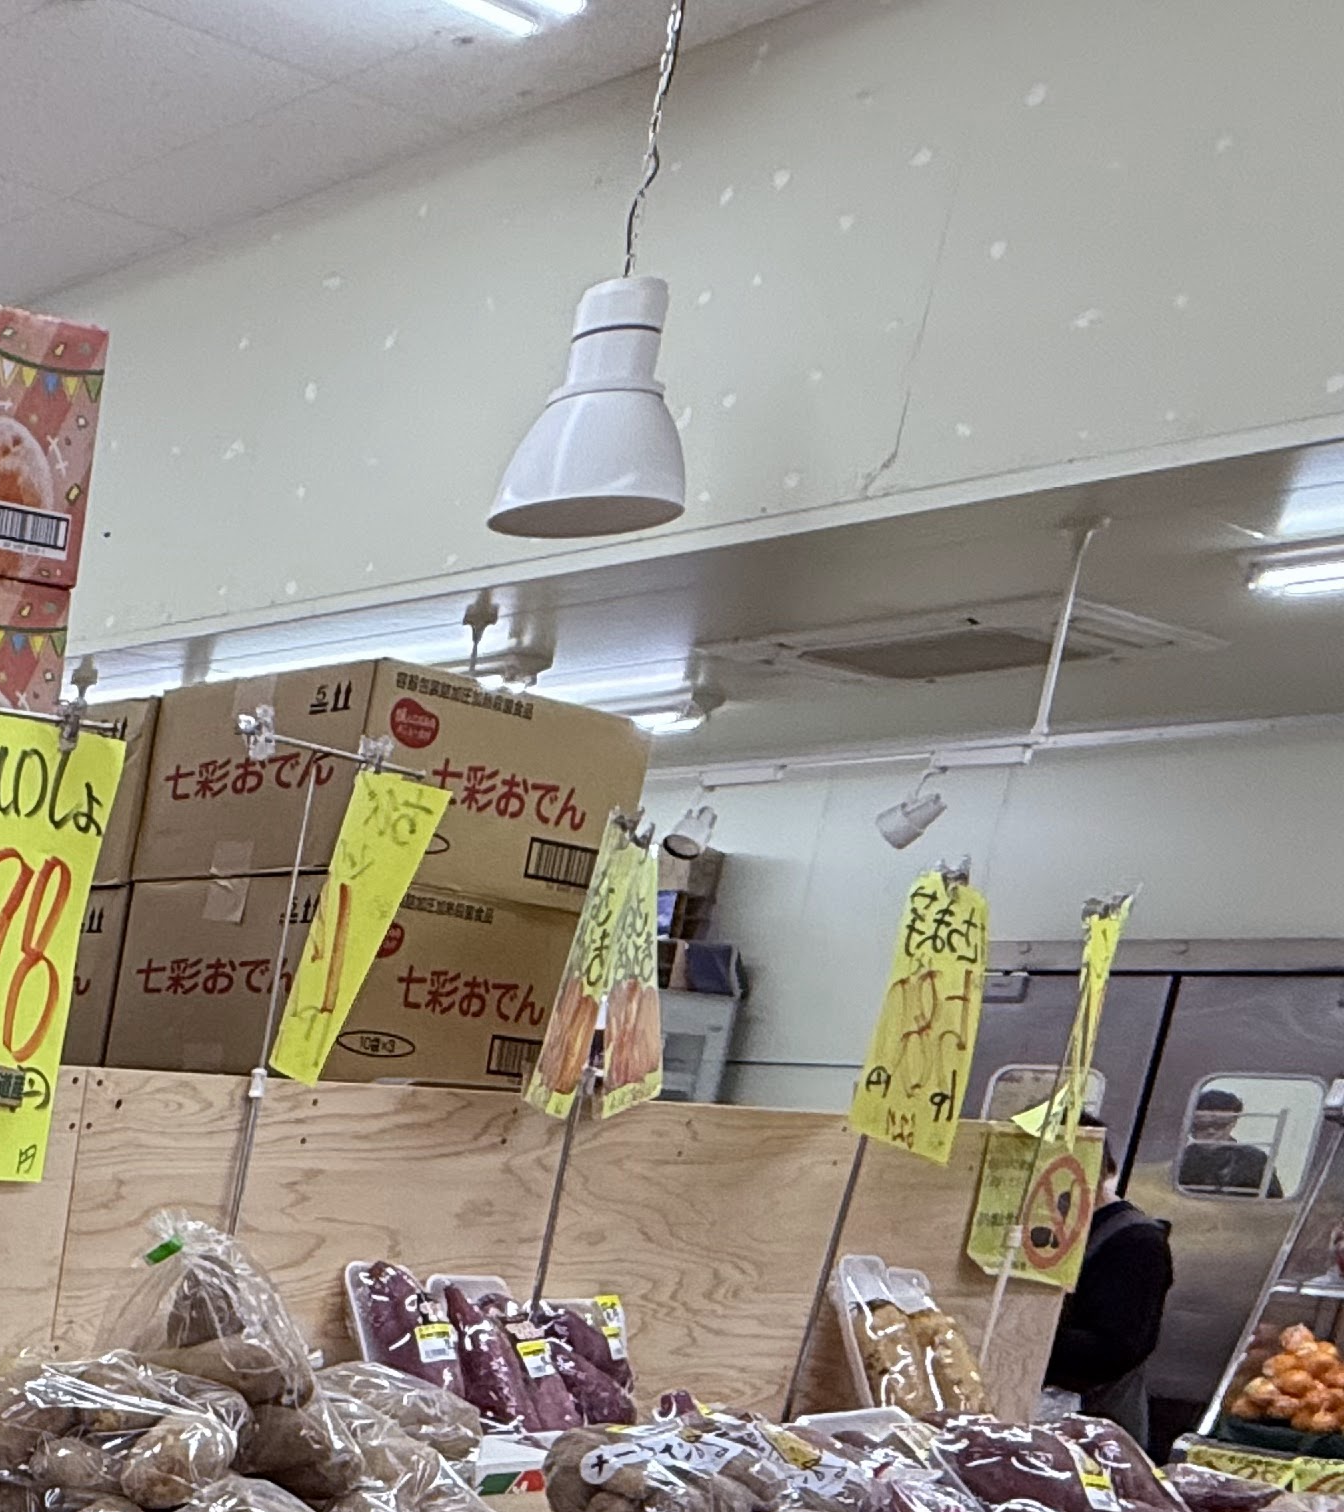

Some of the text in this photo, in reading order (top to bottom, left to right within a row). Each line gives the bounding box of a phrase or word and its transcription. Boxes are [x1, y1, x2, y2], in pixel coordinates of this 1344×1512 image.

[163, 752, 335, 801] 七彩おでん
[431, 758, 587, 832] 七彩おでん
[136, 957, 294, 995] 七彩おでん
[396, 964, 546, 1026] 七彩おでん
[16, 1143, 37, 1175] 円
